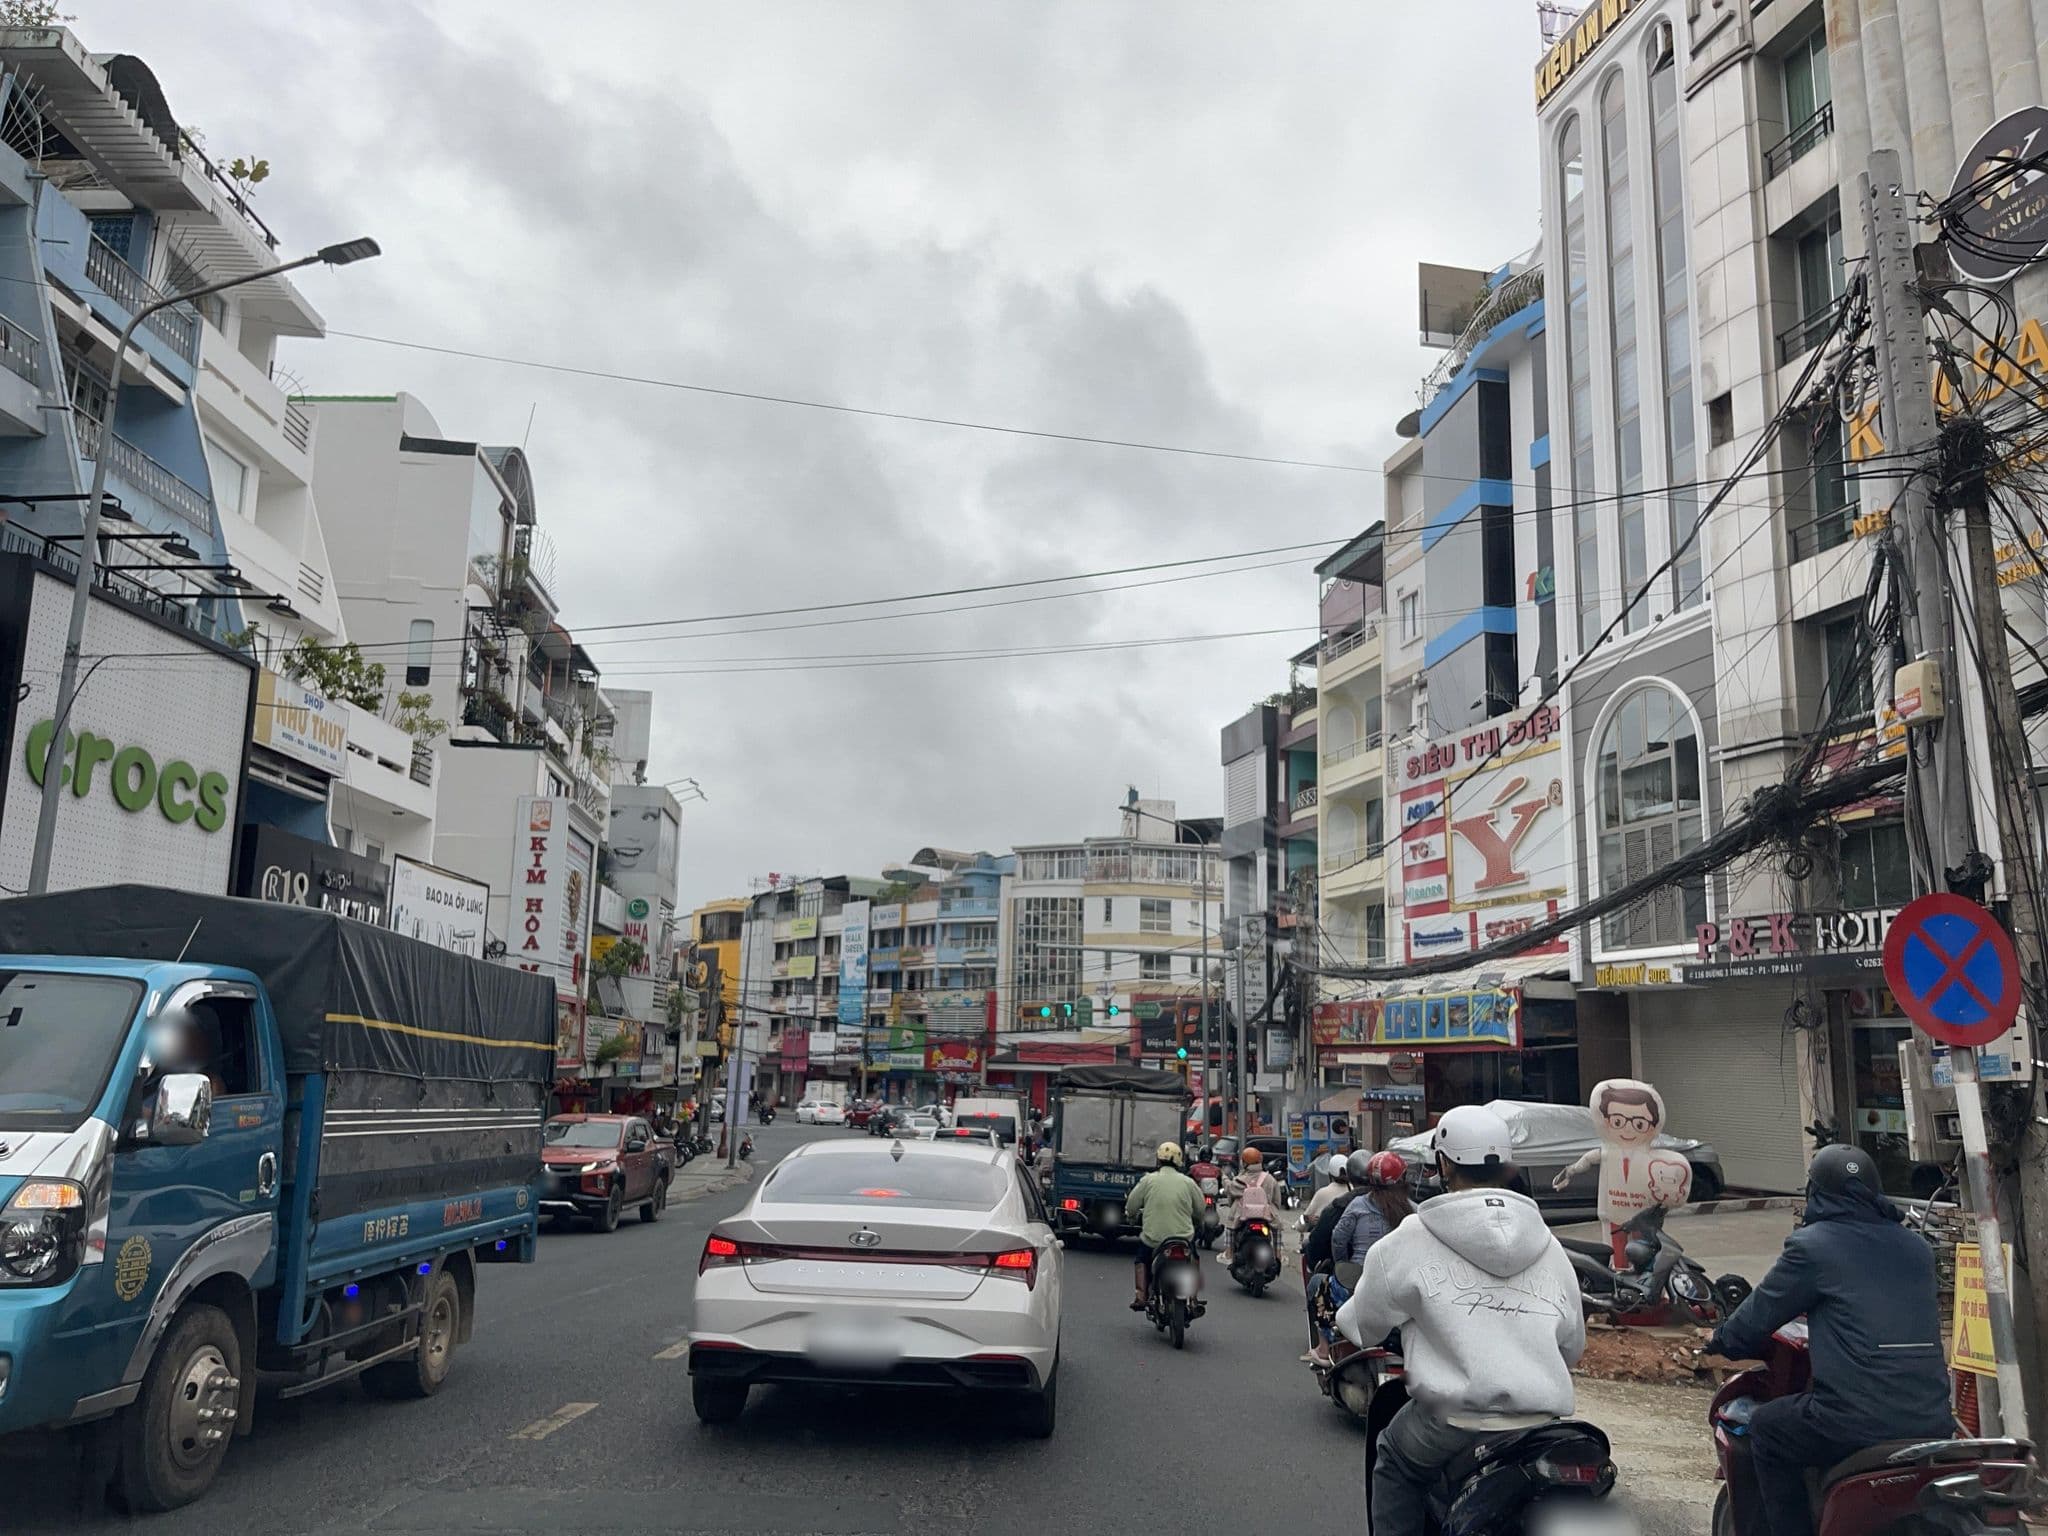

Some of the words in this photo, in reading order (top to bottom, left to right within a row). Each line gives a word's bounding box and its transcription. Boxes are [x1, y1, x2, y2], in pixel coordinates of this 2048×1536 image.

[1575, 9, 1600, 62] AN
[277, 697, 310, 736] NHƯ
[304, 692, 324, 712] SHOP
[1407, 743, 1456, 780] SIÊU
[1461, 727, 1501, 759] THỊ
[26, 719, 229, 833] crocs
[526, 836, 548, 885] KIM
[425, 886, 443, 903] BAO
[443, 892, 454, 908] DA
[1405, 882, 1444, 903] Hisense
[1695, 922, 1719, 960] P
[1728, 918, 1758, 957] &
[1768, 913, 1800, 953] K
[1649, 967, 1671, 983] HOTEL
[1750, 964, 1755, 976] 2
[1758, 963, 1767, 974] P1
[796, 1265, 927, 1280] ELANTRA
